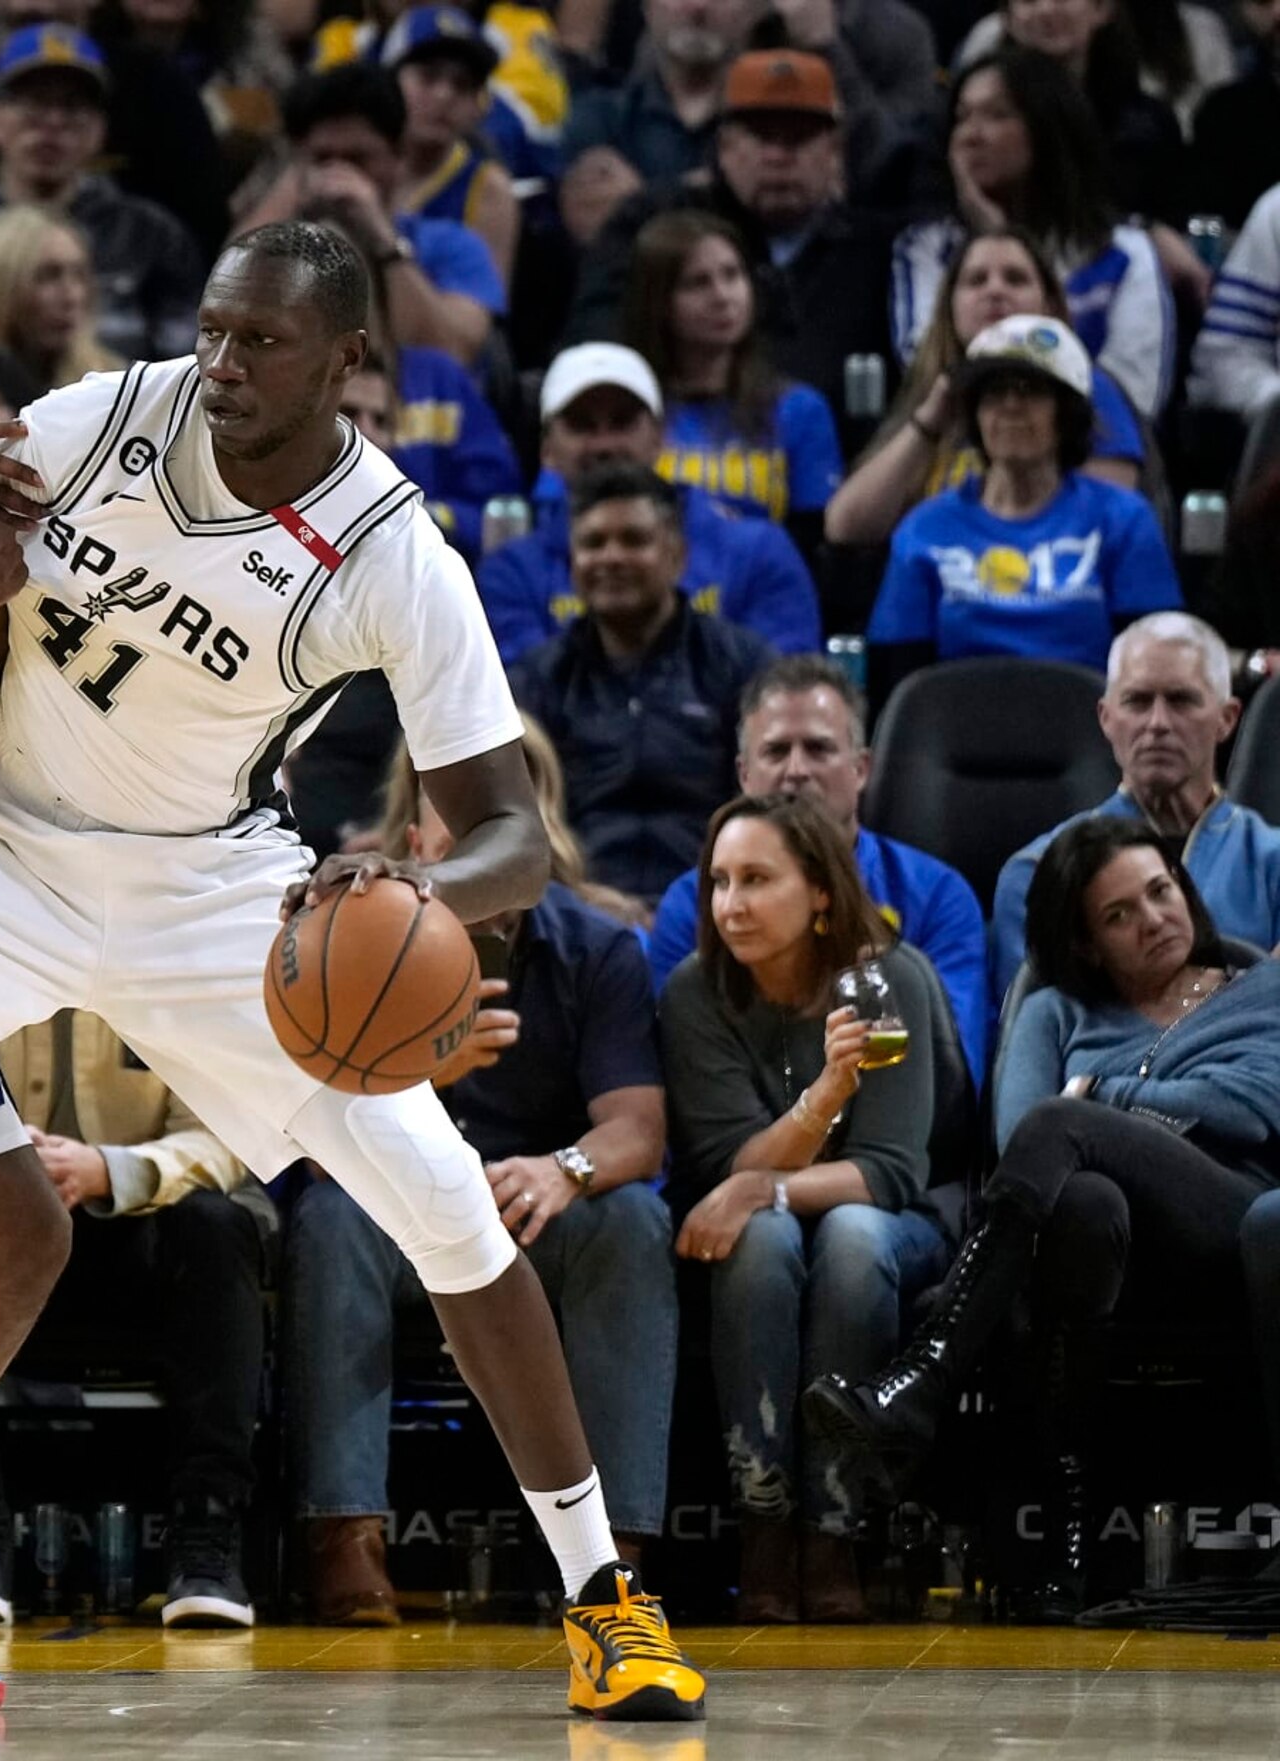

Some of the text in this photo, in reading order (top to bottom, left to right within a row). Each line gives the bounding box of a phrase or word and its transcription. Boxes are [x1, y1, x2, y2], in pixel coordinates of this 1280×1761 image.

[125, 439, 150, 471] 6
[242, 550, 294, 597] Self.
[43, 515, 250, 682] SPURS
[34, 593, 150, 719] 41
[382, 1508, 522, 1545] HASE
